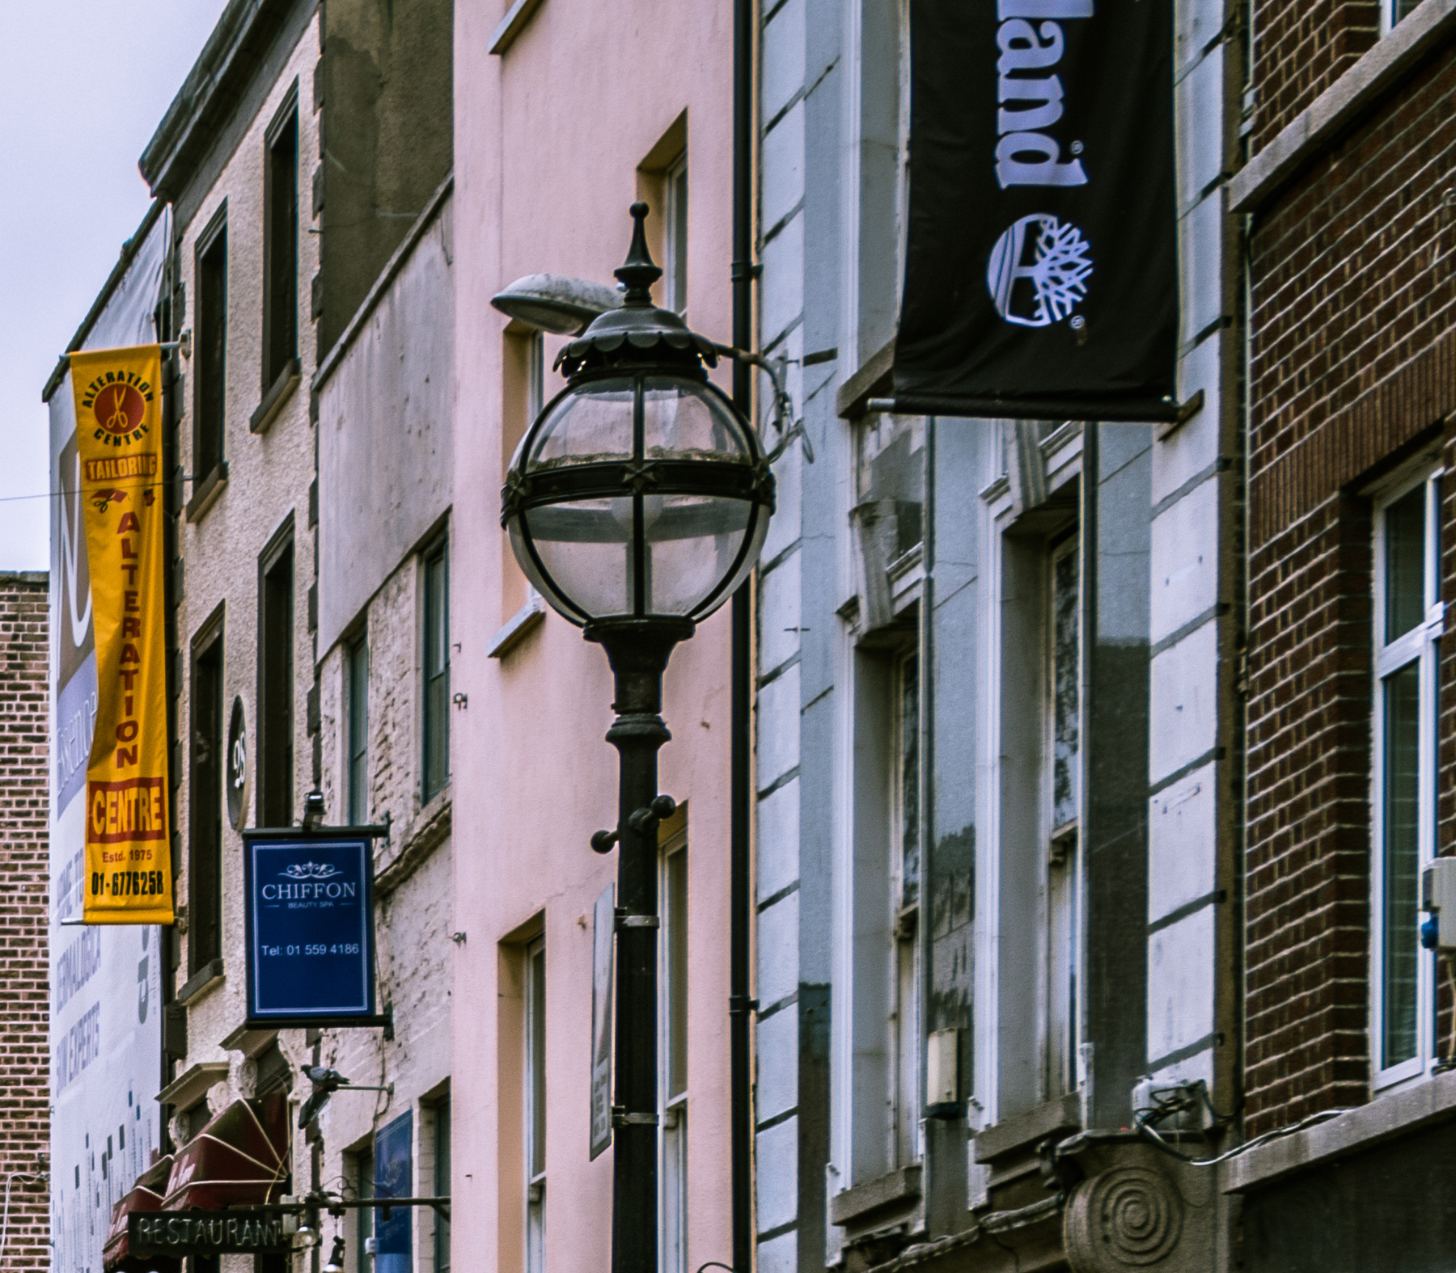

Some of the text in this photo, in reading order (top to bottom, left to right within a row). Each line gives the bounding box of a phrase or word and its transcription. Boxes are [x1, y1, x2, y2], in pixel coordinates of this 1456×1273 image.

[82, 370, 155, 409] ALTERATION
[94, 423, 150, 447] CENTRE
[116, 511, 142, 769] ALTERATION
[92, 786, 162, 835] CENTRE
[102, 850, 153, 863] Estd. 1975
[262, 881, 357, 900] CHIFFON
[262, 943, 360, 956] Tel: 01 559 4186
